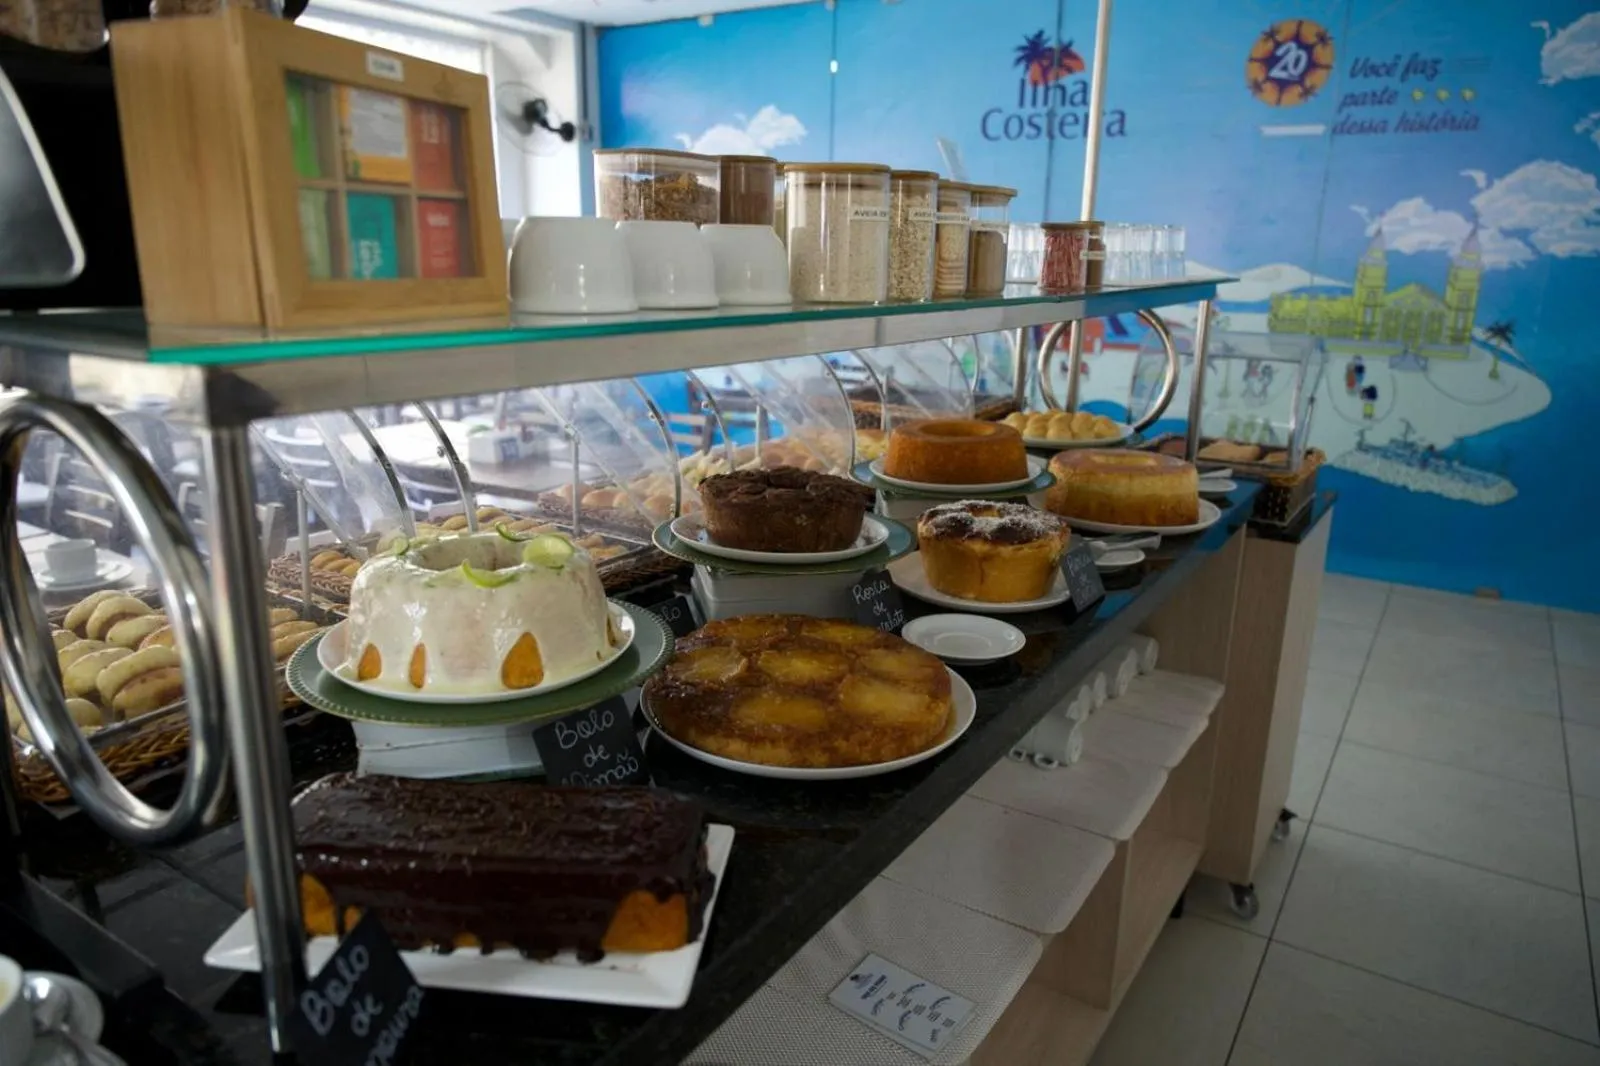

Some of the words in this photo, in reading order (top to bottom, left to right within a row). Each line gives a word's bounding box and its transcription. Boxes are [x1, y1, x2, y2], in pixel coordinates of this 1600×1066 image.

[1269, 41, 1308, 81] 20
[1349, 53, 1401, 80] Você
[1400, 52, 1443, 84] faz
[1337, 86, 1399, 114] parte
[1332, 112, 1389, 137] dessa
[1393, 108, 1480, 134] história
[555, 709, 615, 750] Bolo
[583, 744, 610, 768] de
[300, 944, 369, 1036] Bolo
[351, 993, 383, 1037] de
